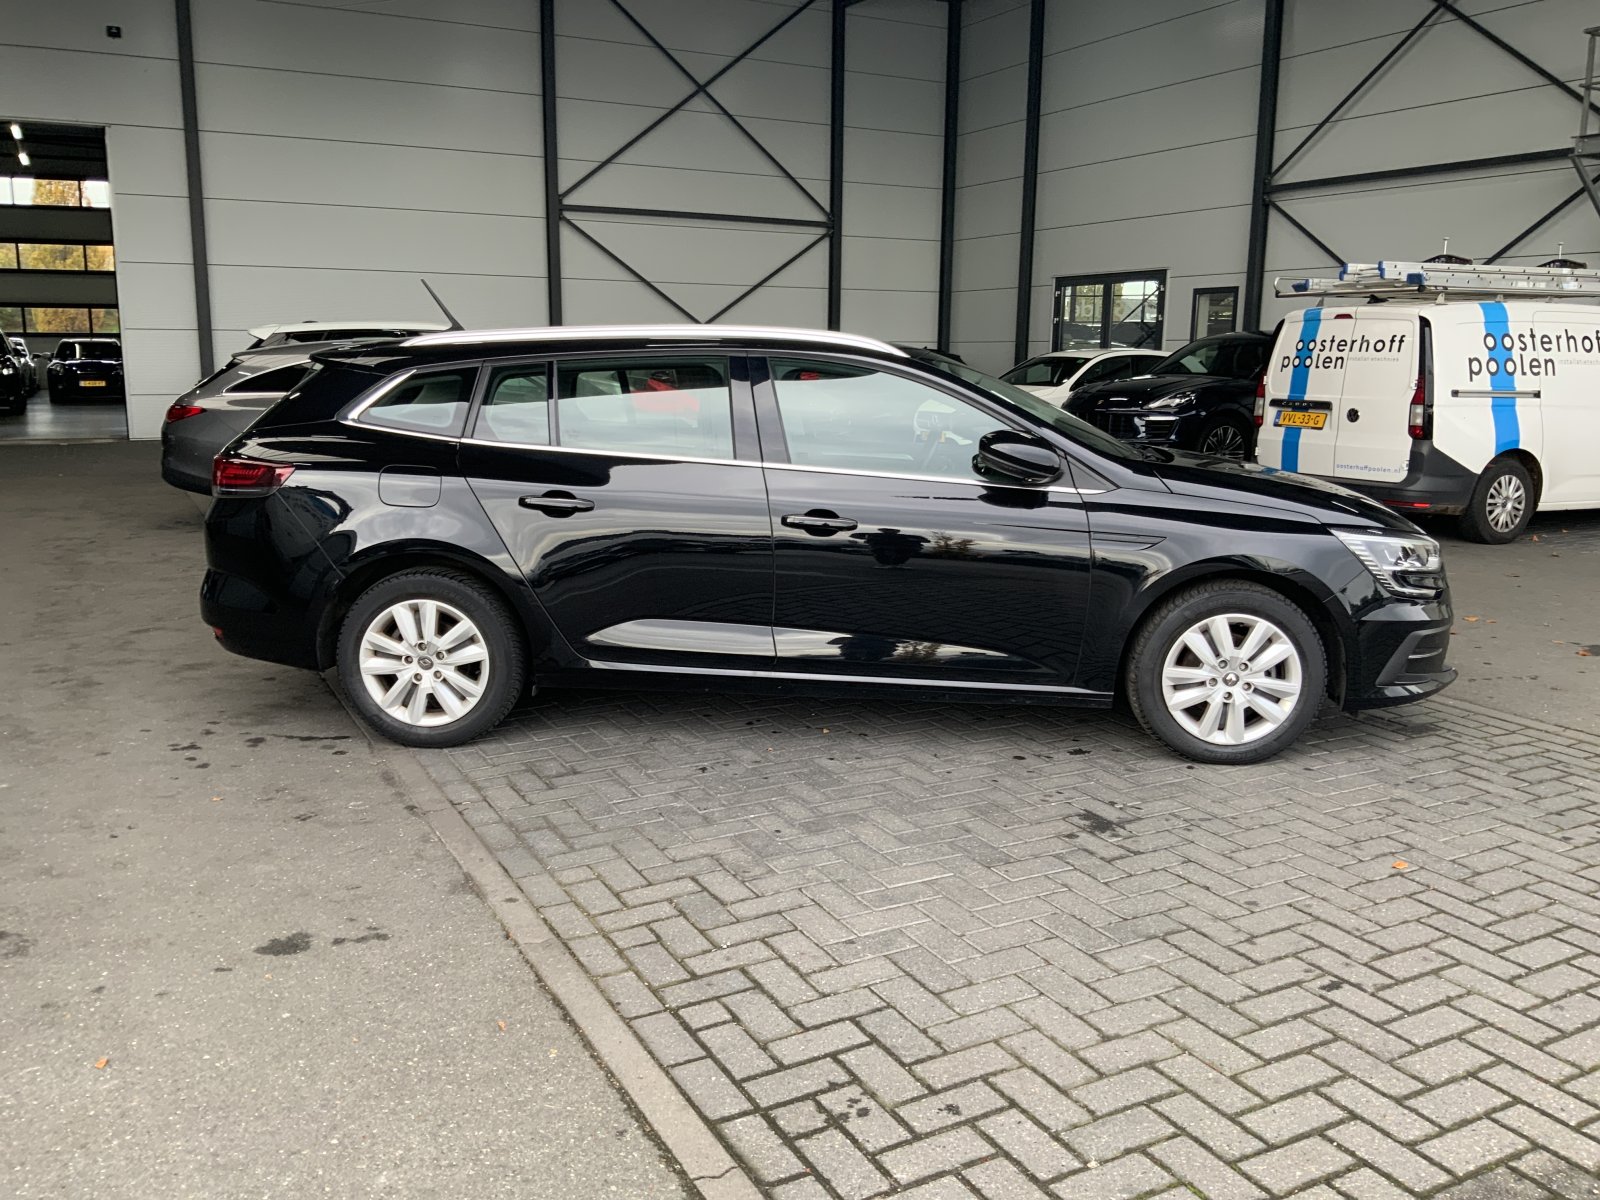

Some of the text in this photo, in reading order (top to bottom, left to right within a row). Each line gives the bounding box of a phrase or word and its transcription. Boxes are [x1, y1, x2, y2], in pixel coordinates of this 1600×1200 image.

[1296, 335, 1406, 352] oosterhoff
[1280, 353, 1345, 372] poolen
[1468, 353, 1556, 382] poolen
[1282, 412, 1320, 425] VVL-33-G
[1336, 464, 1401, 473] oosterhoffpoolen.nl
